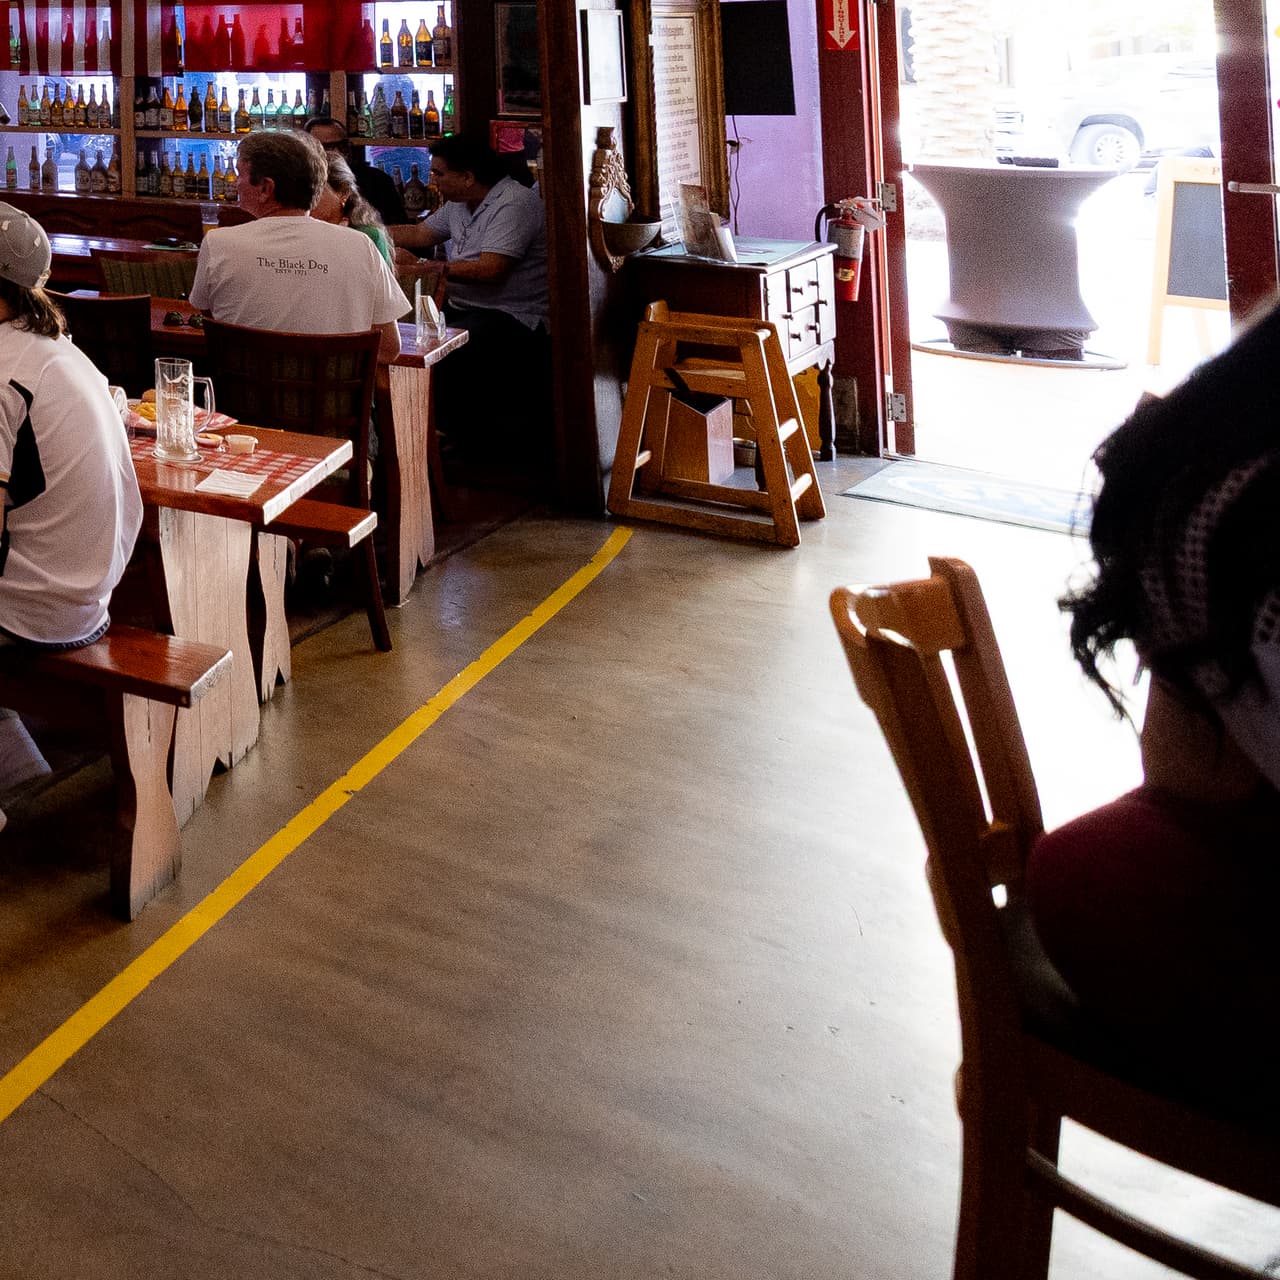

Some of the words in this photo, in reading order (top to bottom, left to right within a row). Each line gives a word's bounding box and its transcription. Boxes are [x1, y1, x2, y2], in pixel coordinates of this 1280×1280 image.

[256, 256, 276, 268] The
[278, 258, 305, 269] Black
[308, 259, 329, 274] Dog
